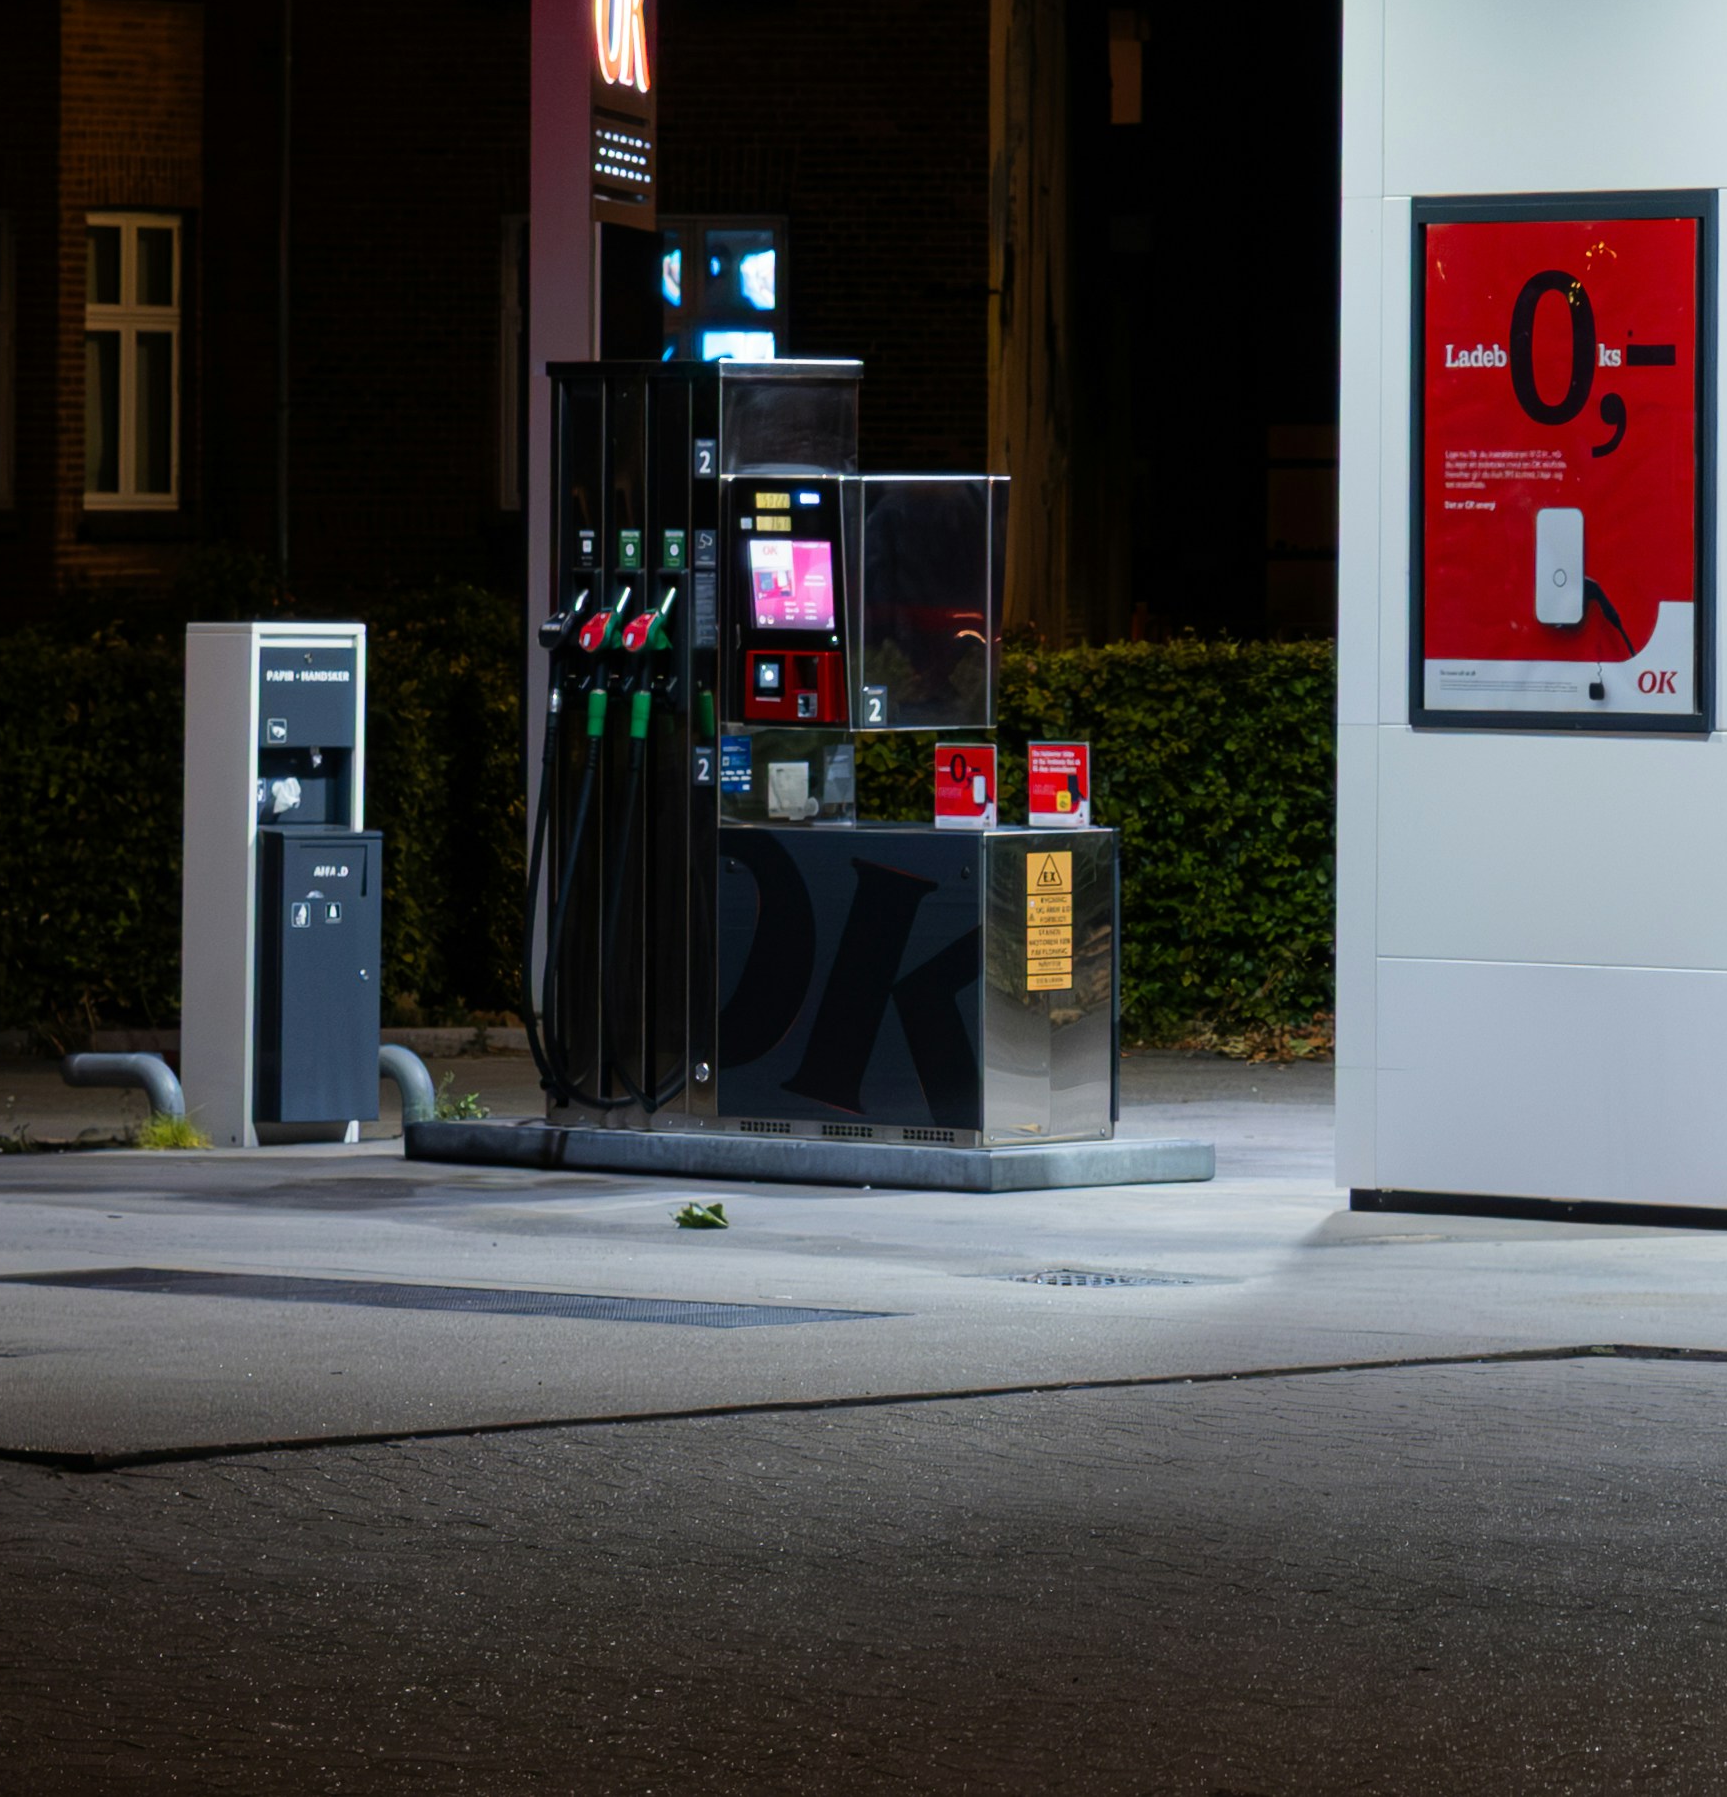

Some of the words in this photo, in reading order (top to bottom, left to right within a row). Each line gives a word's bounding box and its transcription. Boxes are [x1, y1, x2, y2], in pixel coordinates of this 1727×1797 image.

[1445, 344, 1508, 368] Ladeb
[1598, 343, 1622, 367] ks
[699, 450, 711, 474] 2
[1637, 670, 1678, 695] OK
[868, 697, 882, 723] 2
[697, 758, 710, 781] 2
[1043, 871, 1056, 883] EX
